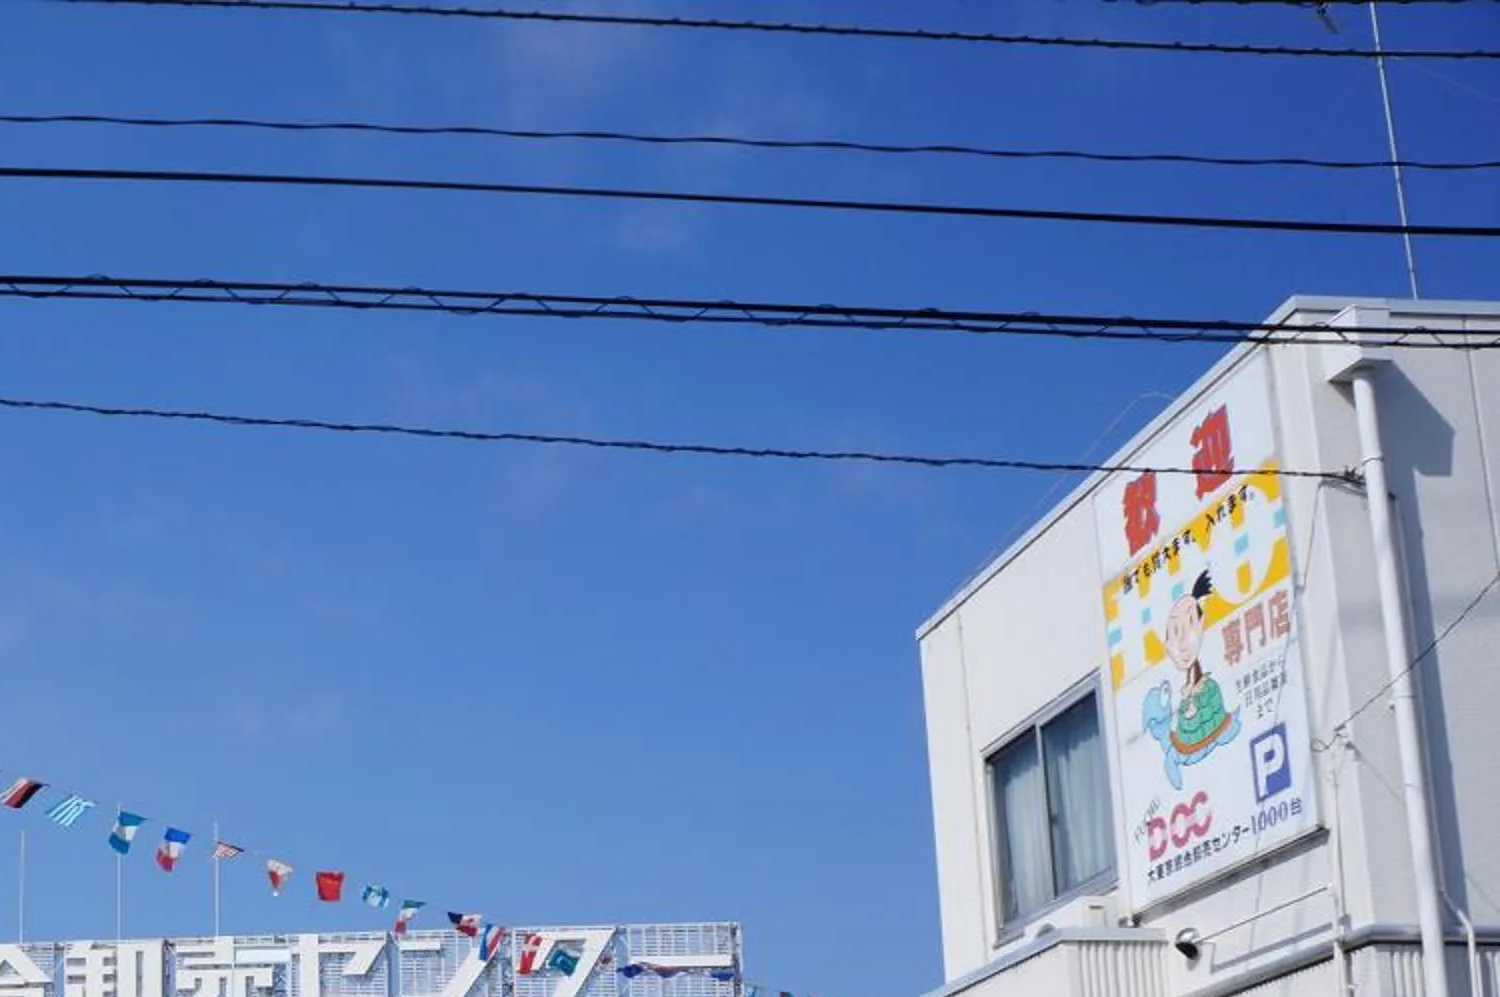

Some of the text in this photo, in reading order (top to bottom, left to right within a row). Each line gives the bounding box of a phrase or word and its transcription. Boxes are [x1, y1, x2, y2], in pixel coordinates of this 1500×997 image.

[1222, 589, 1292, 667] 専門店
[1251, 797, 1303, 835] 1000台
